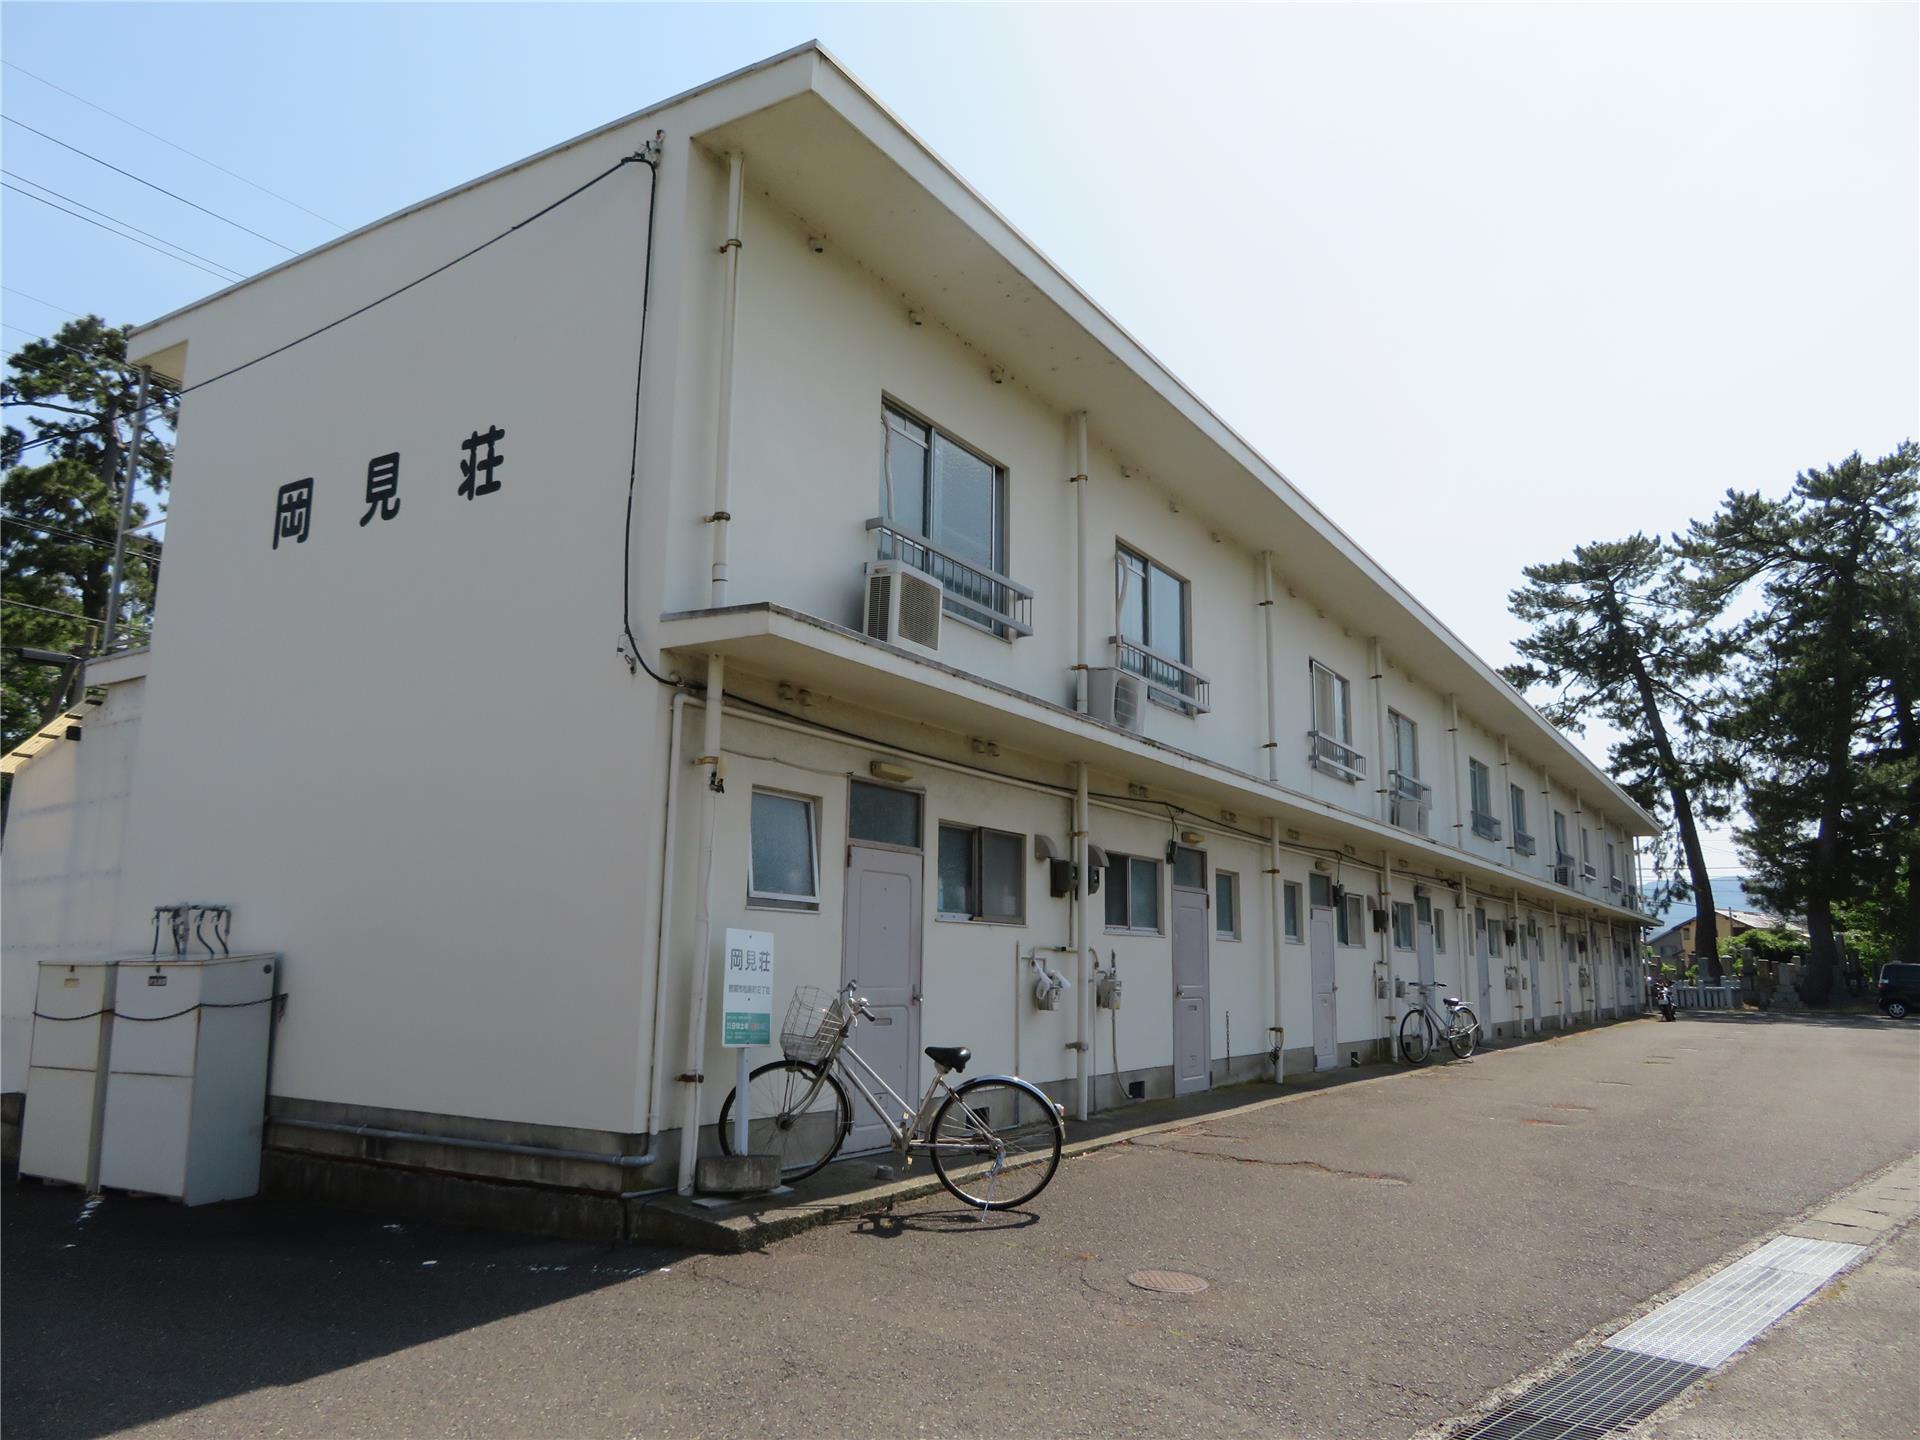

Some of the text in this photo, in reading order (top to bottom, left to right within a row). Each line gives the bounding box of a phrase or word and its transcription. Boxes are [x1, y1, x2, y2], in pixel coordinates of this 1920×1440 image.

[272, 424, 505, 550] 岡見荘
[730, 948, 771, 972] 岡見荘
